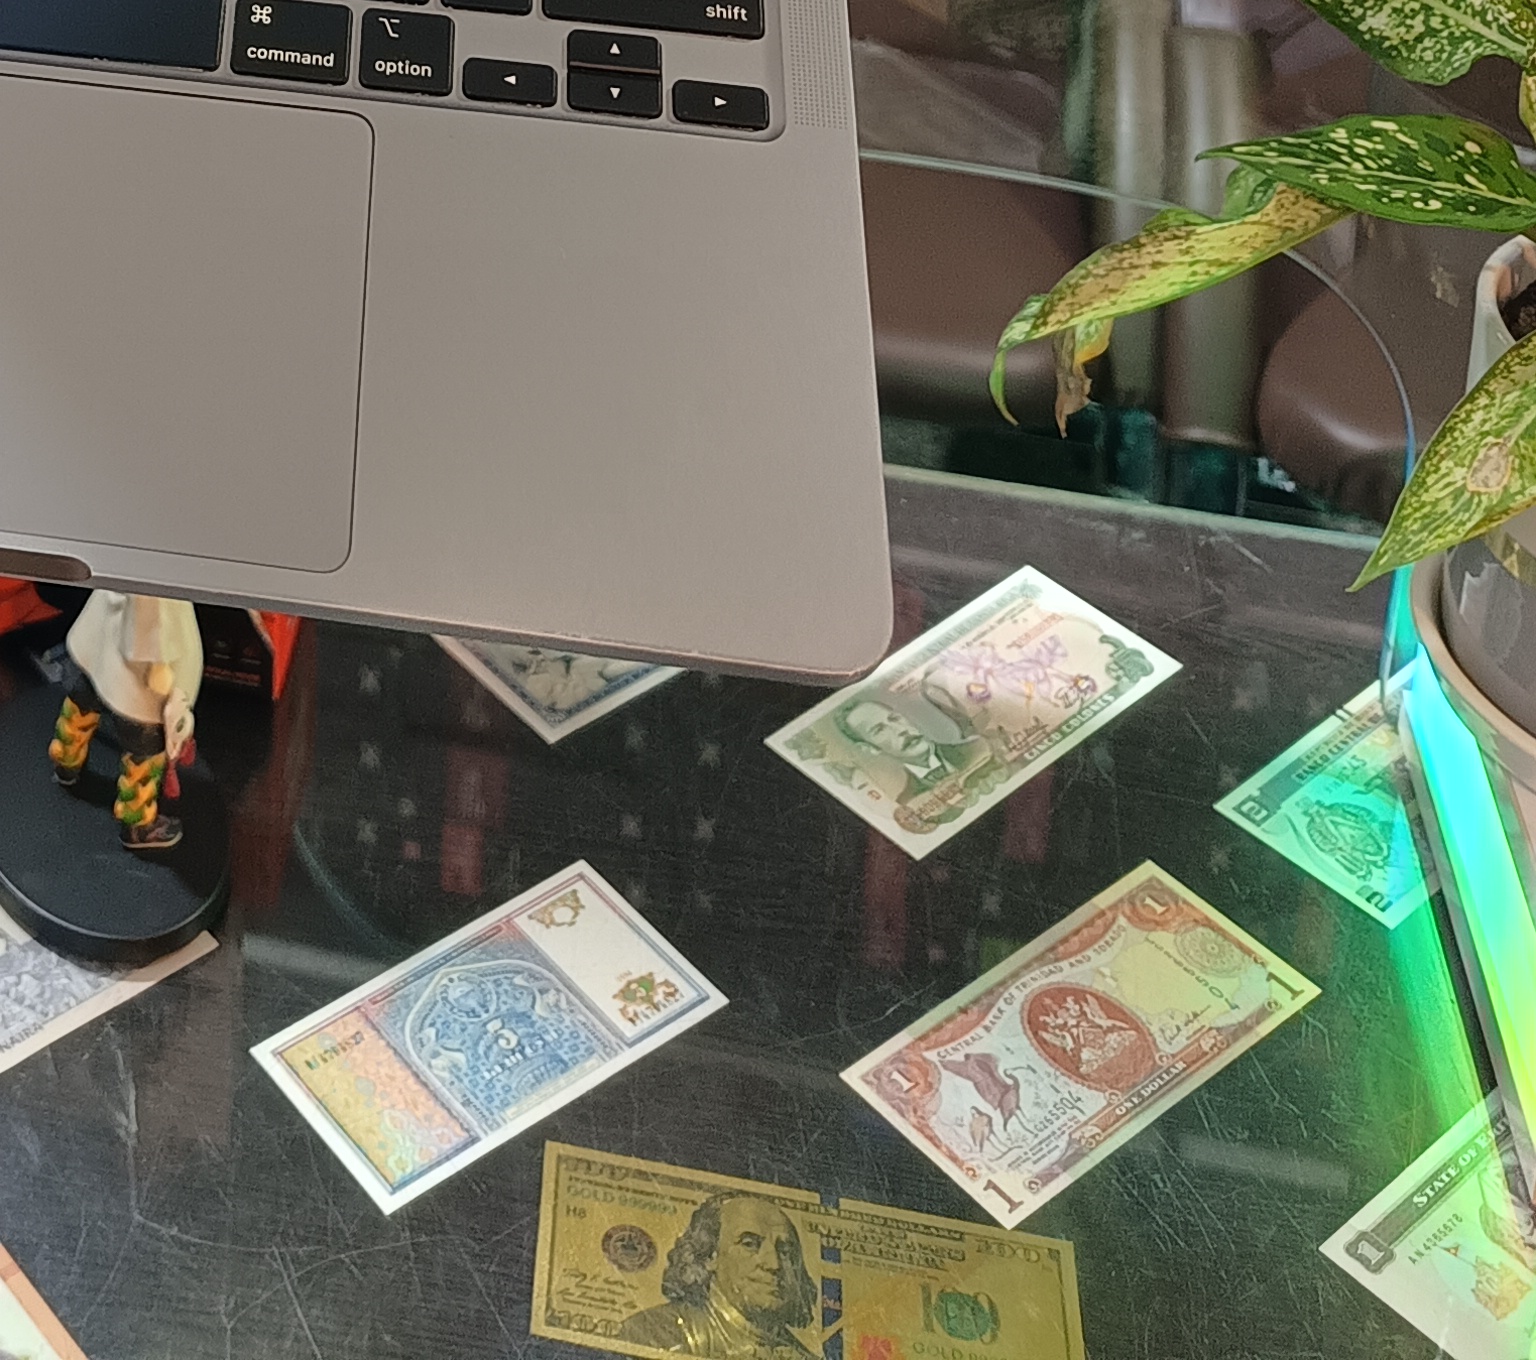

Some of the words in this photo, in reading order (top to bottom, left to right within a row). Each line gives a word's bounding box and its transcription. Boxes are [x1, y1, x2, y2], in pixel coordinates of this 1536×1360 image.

[705, 3, 748, 21] shift
[246, 46, 335, 67] command
[374, 59, 432, 78] option
[1143, 896, 1168, 915] 1
[1266, 973, 1305, 1001] 1
[936, 1030, 982, 1060] CENTRAL
[982, 1006, 1006, 1034] BANK
[1068, 953, 1093, 970] AND
[890, 1070, 917, 1092] 1
[1115, 1095, 1141, 1117] ONE
[1140, 1060, 1187, 1100] DOLLAR
[983, 1179, 1025, 1214] 1
[1413, 1163, 1460, 1208] STATE
[1357, 1241, 1386, 1264] 1
